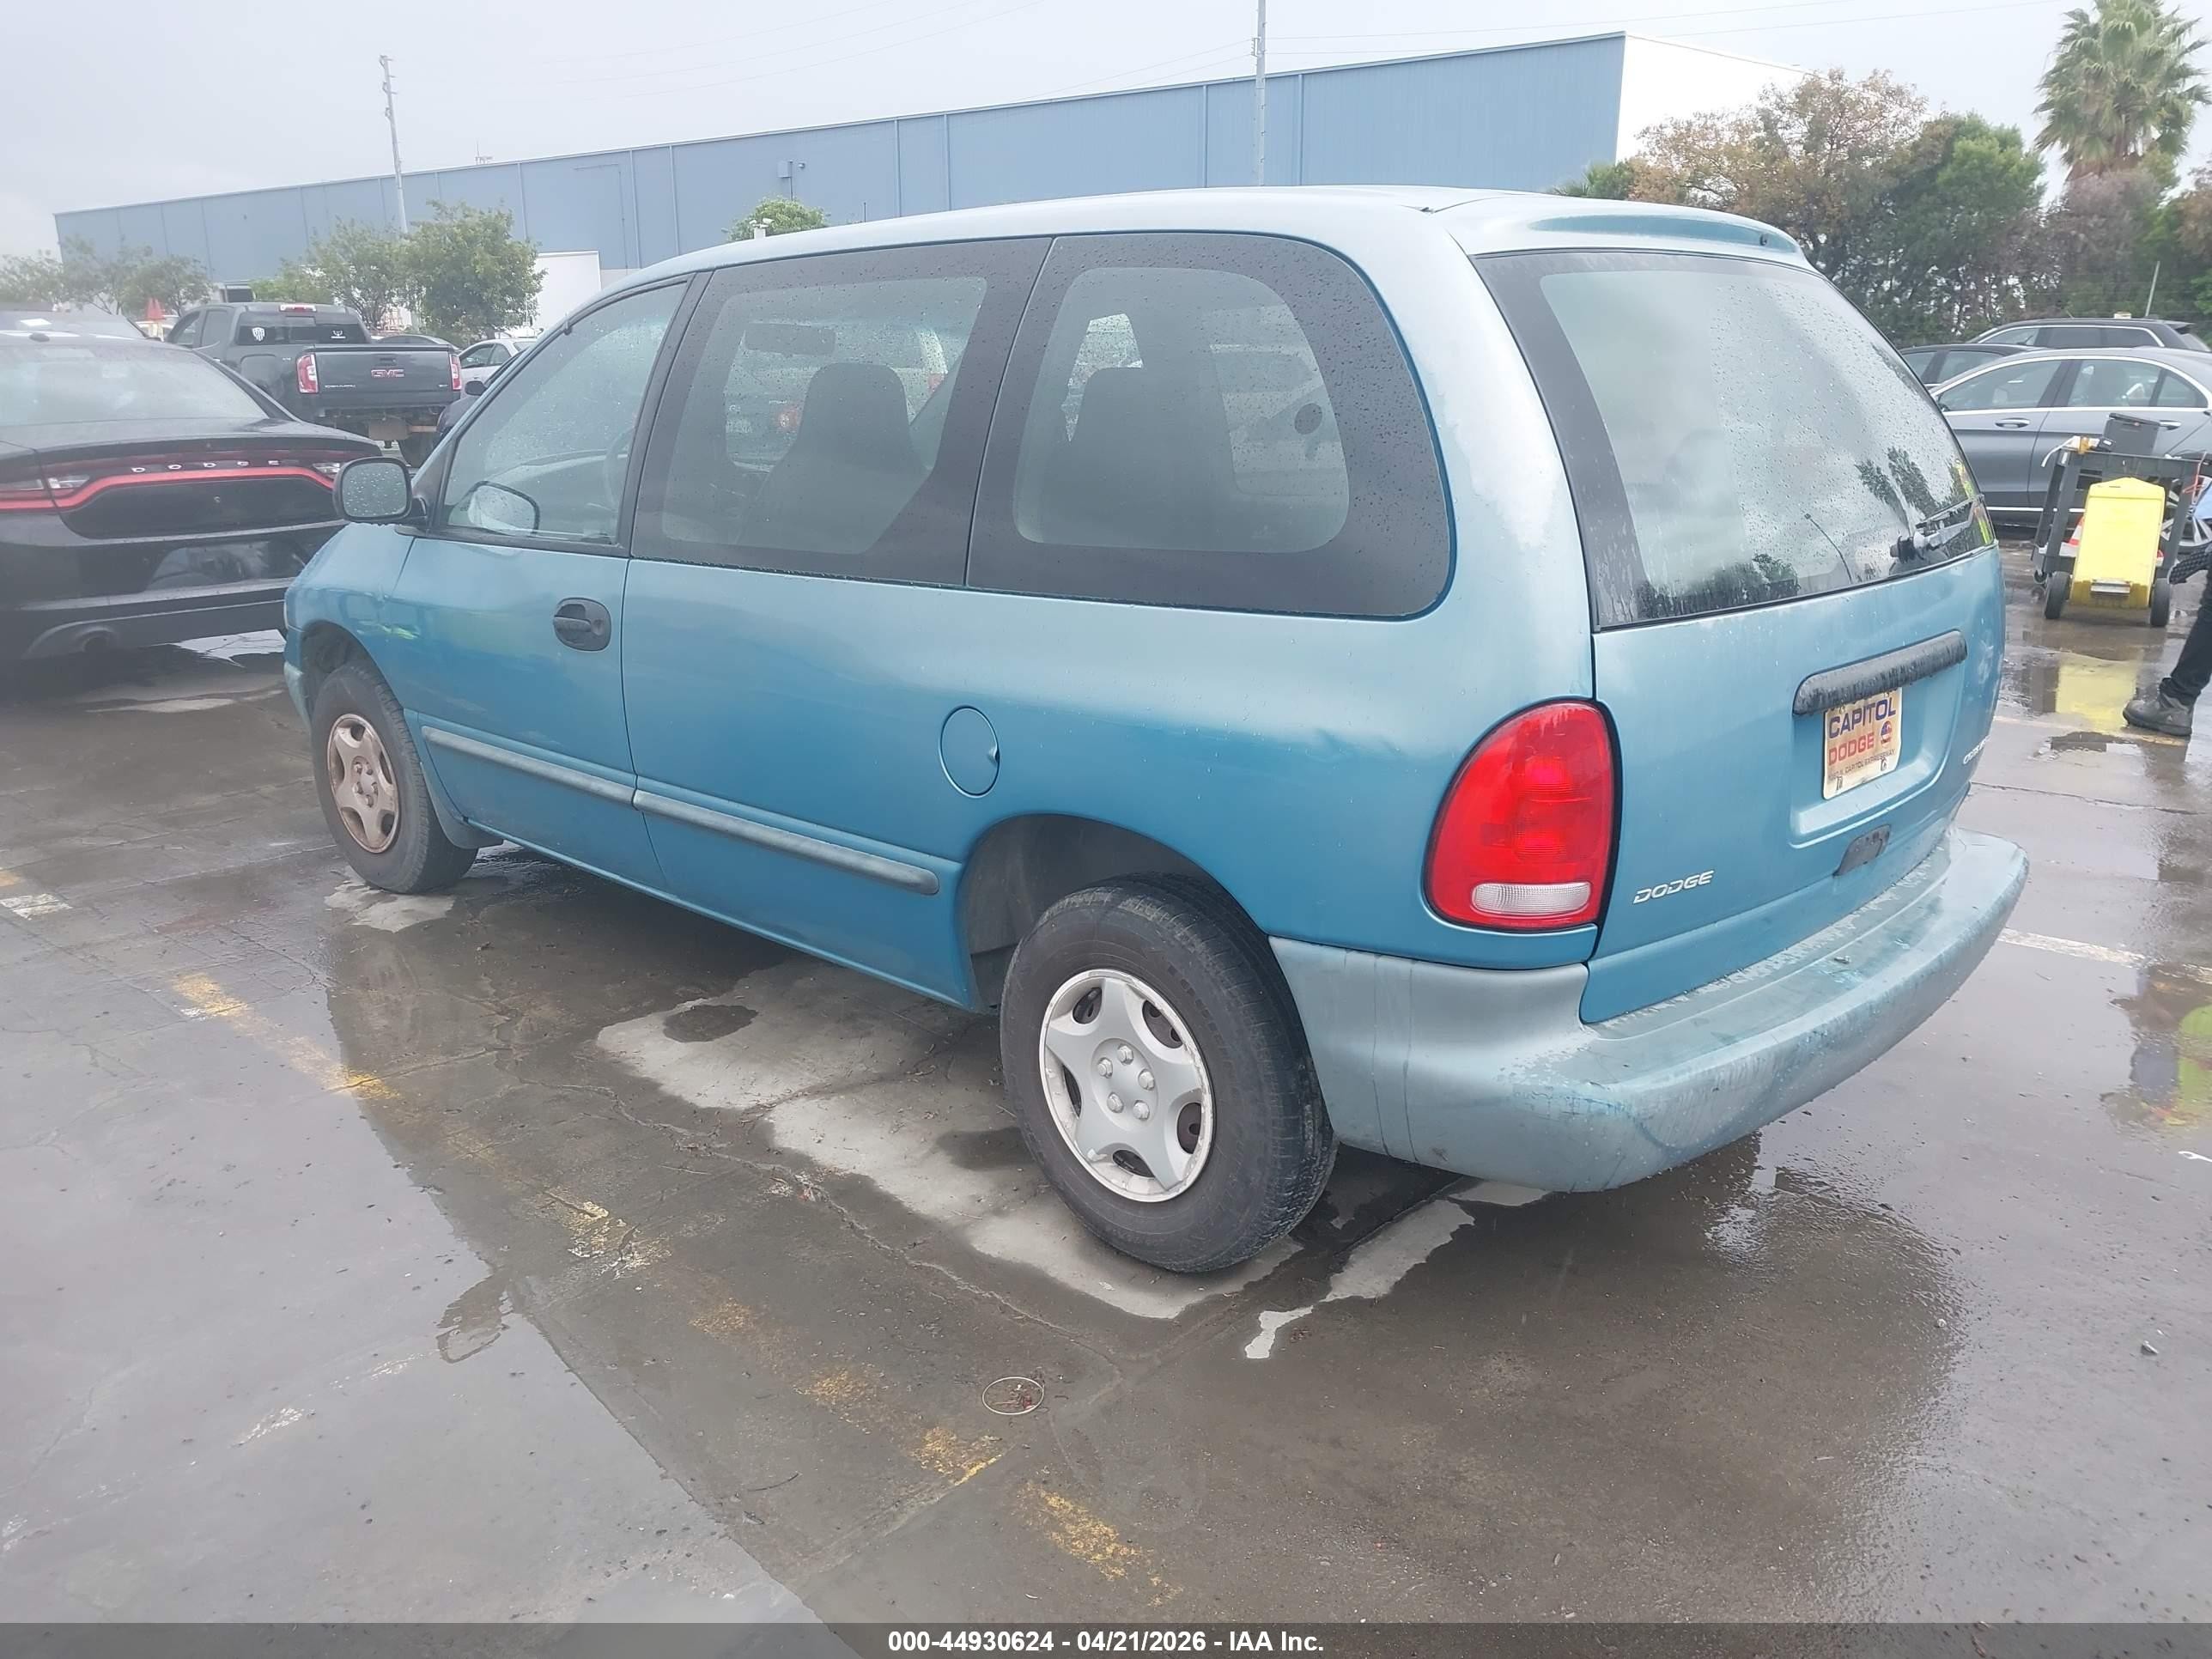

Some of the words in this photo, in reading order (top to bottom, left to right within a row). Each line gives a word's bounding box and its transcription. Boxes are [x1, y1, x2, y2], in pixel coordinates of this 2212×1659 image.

[371, 368, 405, 378] GMC
[131, 459, 280, 473] DODGE
[1828, 697, 1896, 739] CAPITOL
[1828, 732, 1875, 767] DODGE
[1633, 870, 1715, 904] DODGE
